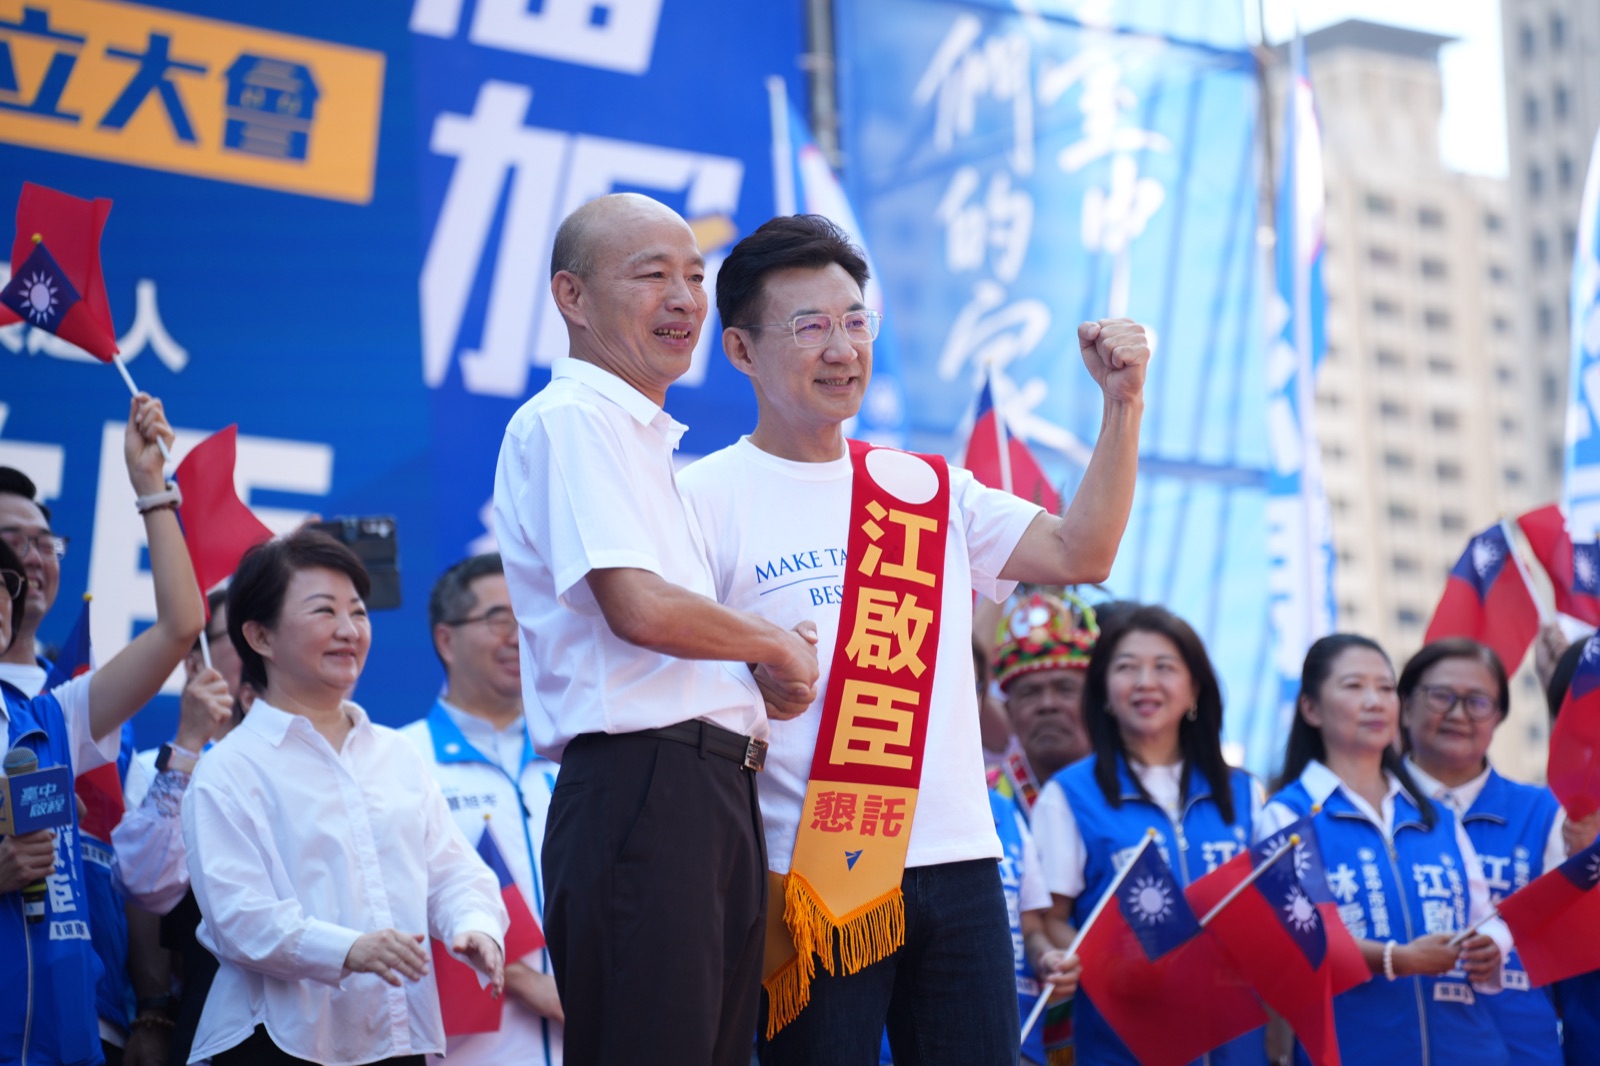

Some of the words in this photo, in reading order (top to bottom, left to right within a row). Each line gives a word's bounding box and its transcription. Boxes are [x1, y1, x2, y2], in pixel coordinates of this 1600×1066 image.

[0, 6, 322, 164] 立大會
[408, 0, 745, 399] 加
[755, 549, 823, 584] MAKE
[808, 584, 845, 606] BES
[828, 499, 939, 770] 江啟臣
[810, 790, 907, 838] 懇託
